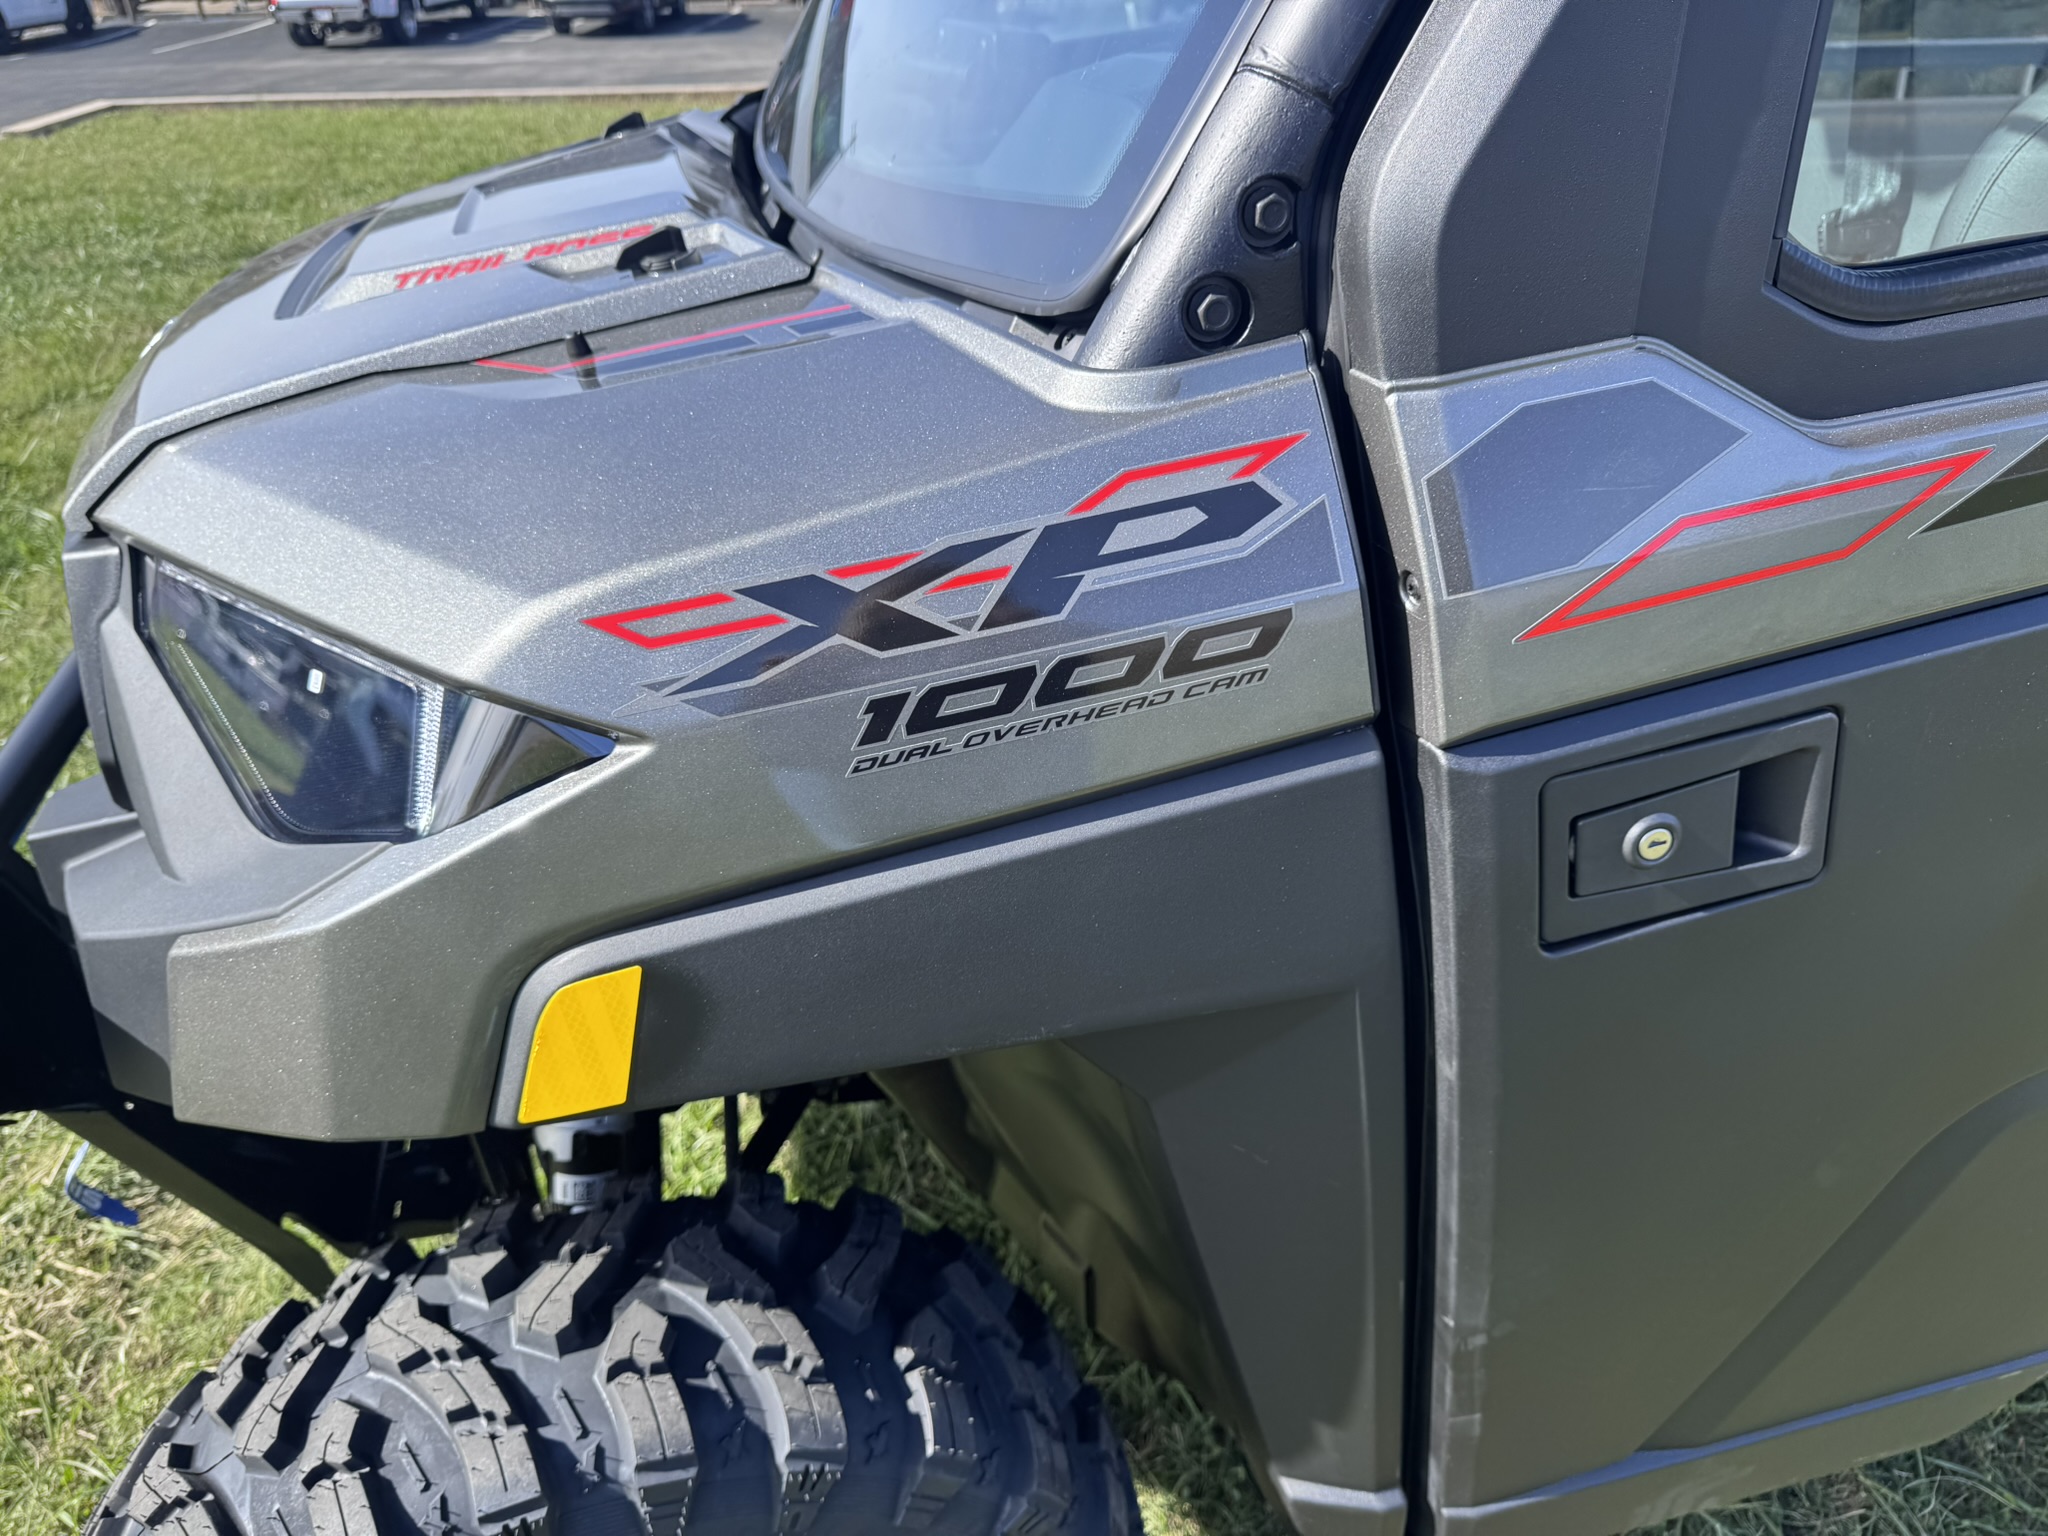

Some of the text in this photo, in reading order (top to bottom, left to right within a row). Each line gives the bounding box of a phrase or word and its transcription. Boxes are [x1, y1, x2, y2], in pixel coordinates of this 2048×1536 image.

[662, 480, 1283, 697] XP
[850, 668, 1269, 775] DUAL OVERHEAD CAM
[857, 607, 1294, 748] 1000
